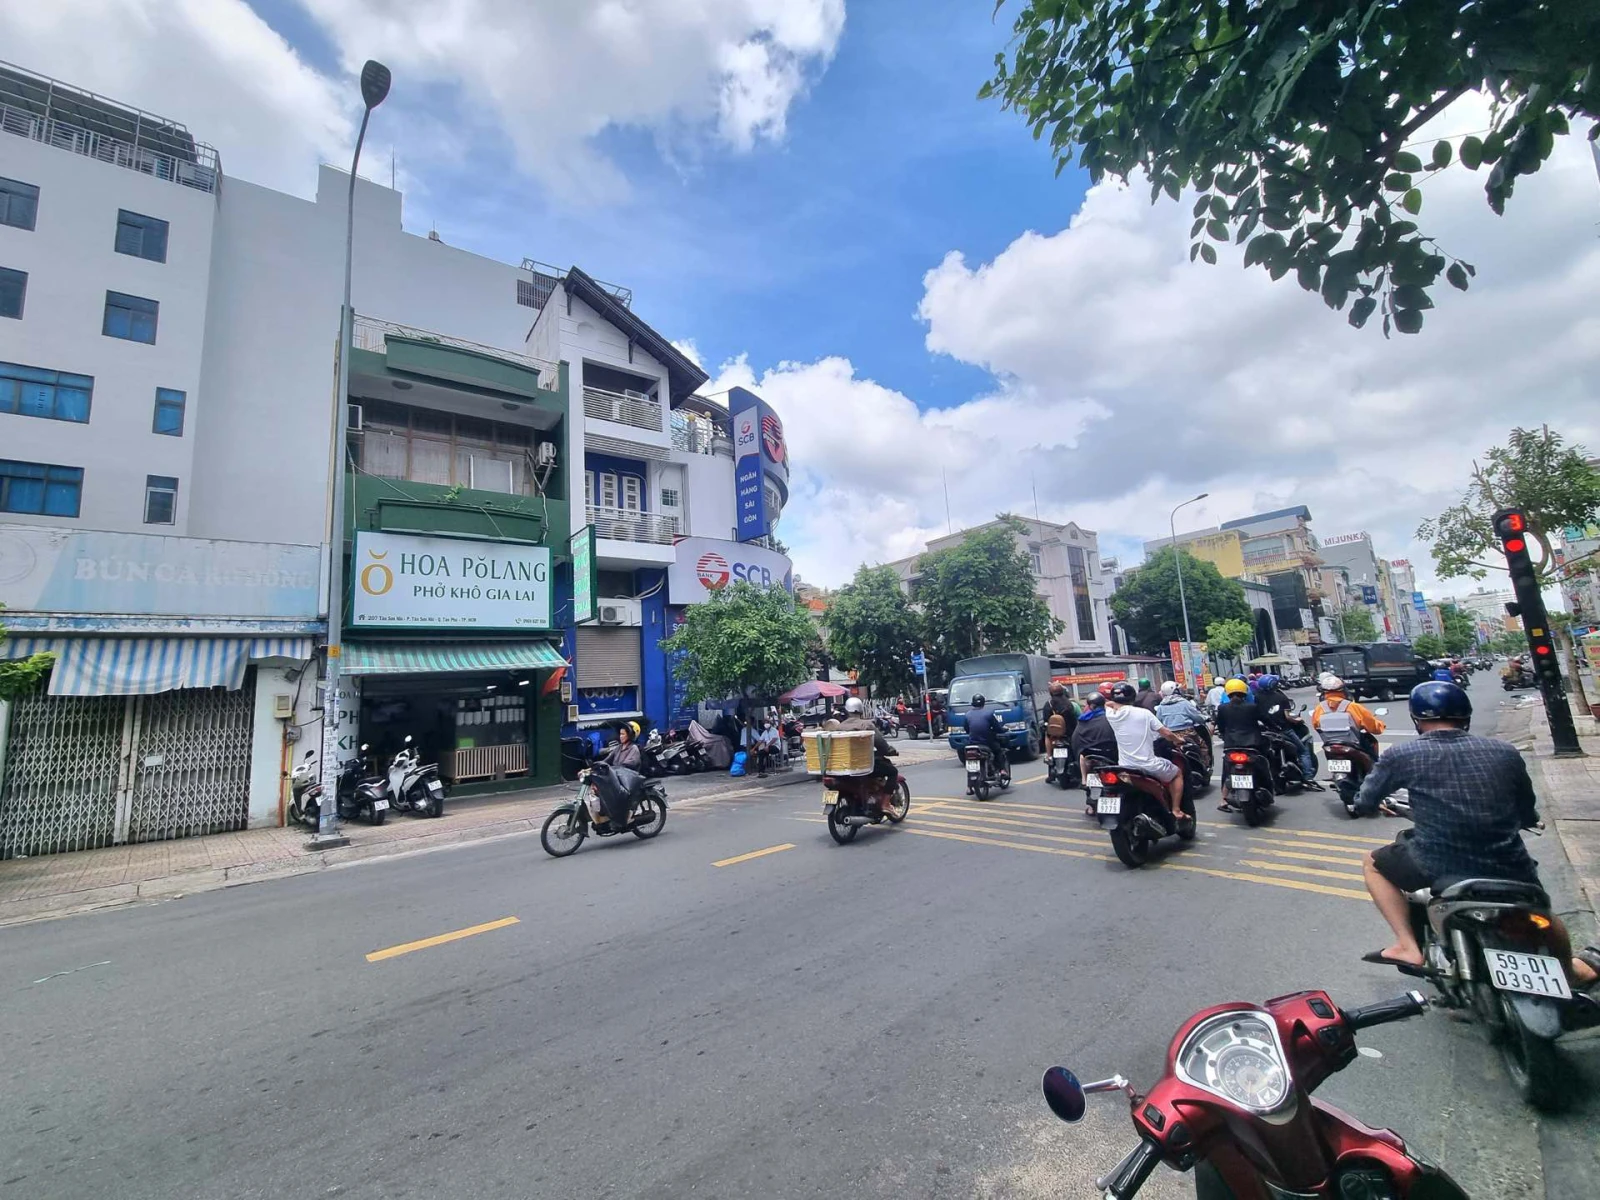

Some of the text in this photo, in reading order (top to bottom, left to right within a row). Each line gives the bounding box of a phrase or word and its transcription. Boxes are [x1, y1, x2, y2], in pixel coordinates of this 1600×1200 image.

[738, 432, 755, 447] SCB
[400, 553, 450, 577] HOA
[732, 562, 772, 590] SCB
[413, 581, 535, 602] PHỞ KHÔ GIA LAI
[1495, 970, 1564, 995] 039.11
